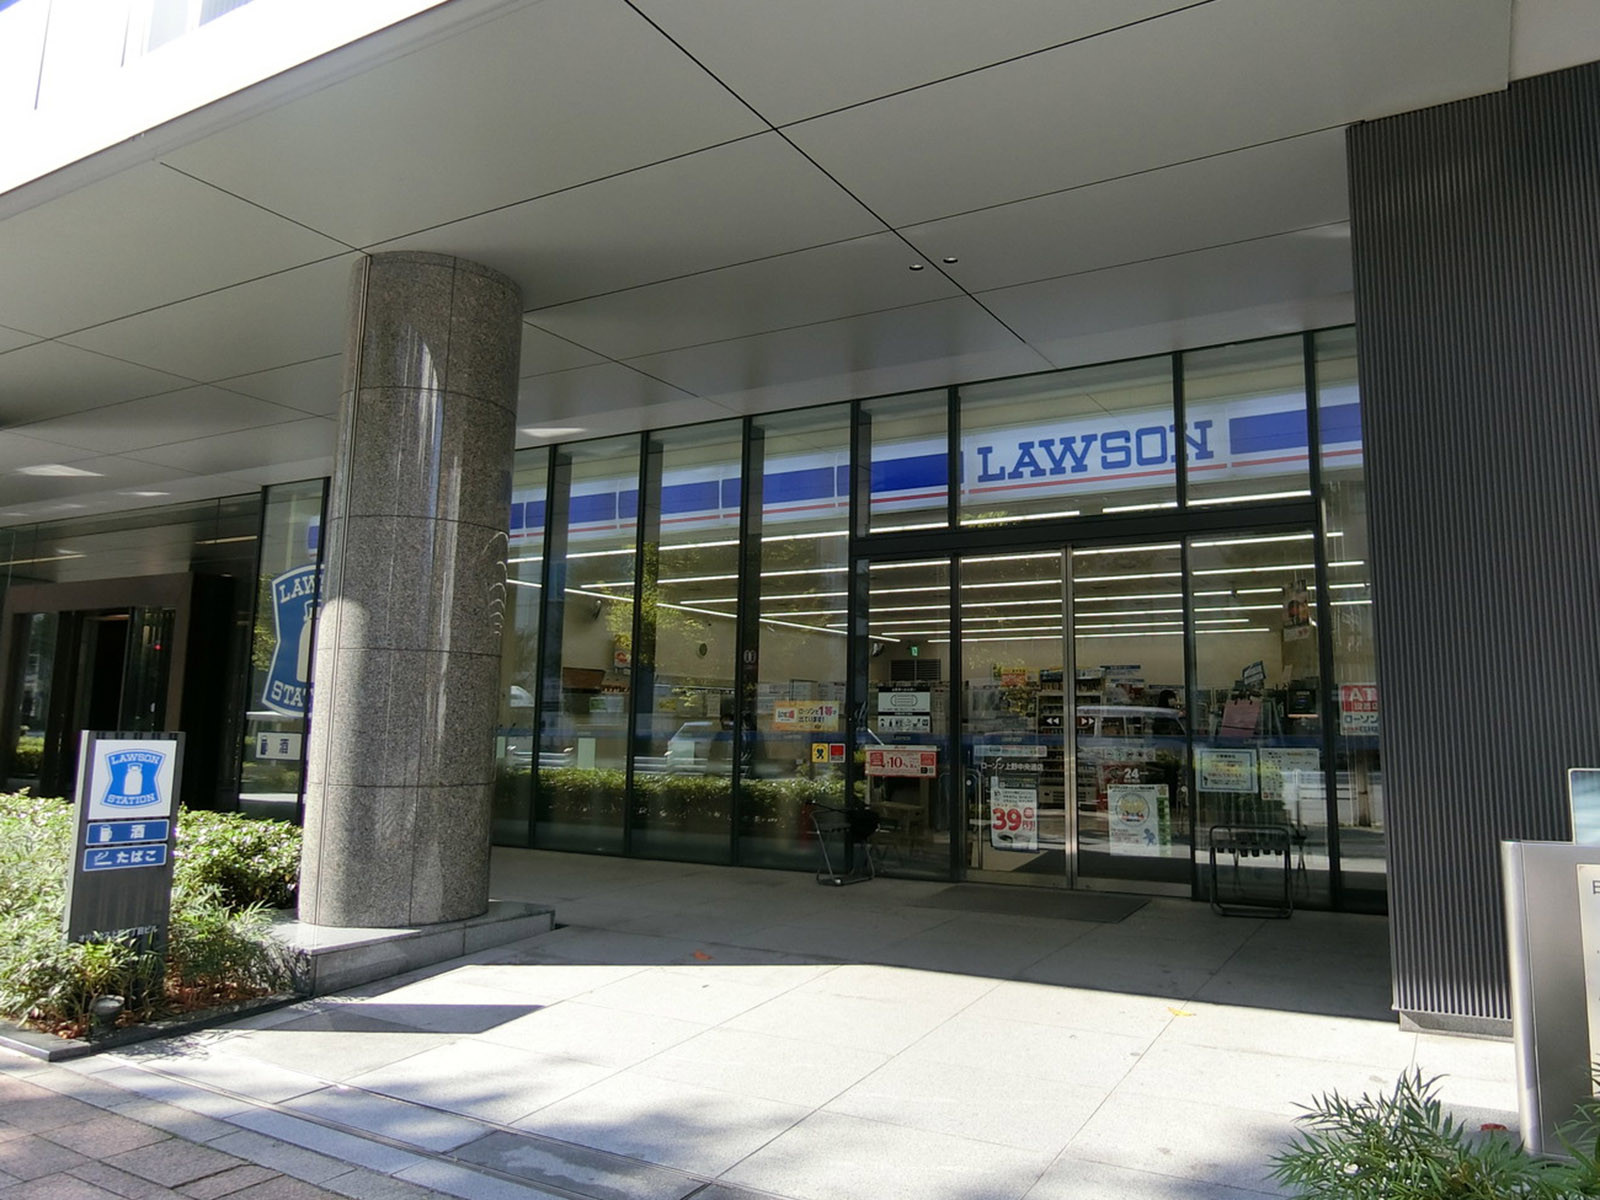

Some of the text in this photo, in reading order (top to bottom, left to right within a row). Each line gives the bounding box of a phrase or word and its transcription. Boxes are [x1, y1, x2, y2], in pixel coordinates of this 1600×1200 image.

[977, 419, 1214, 483] LAWSON
[279, 574, 323, 603] LAW
[271, 680, 307, 707] STA
[1344, 715, 1378, 724] ローソン
[111, 752, 161, 765] LAWSON
[981, 762, 1005, 770] ローソン
[1124, 767, 1139, 779] 24
[107, 793, 156, 805] STATION
[130, 824, 146, 839] 酒
[116, 850, 157, 864] たばこ
